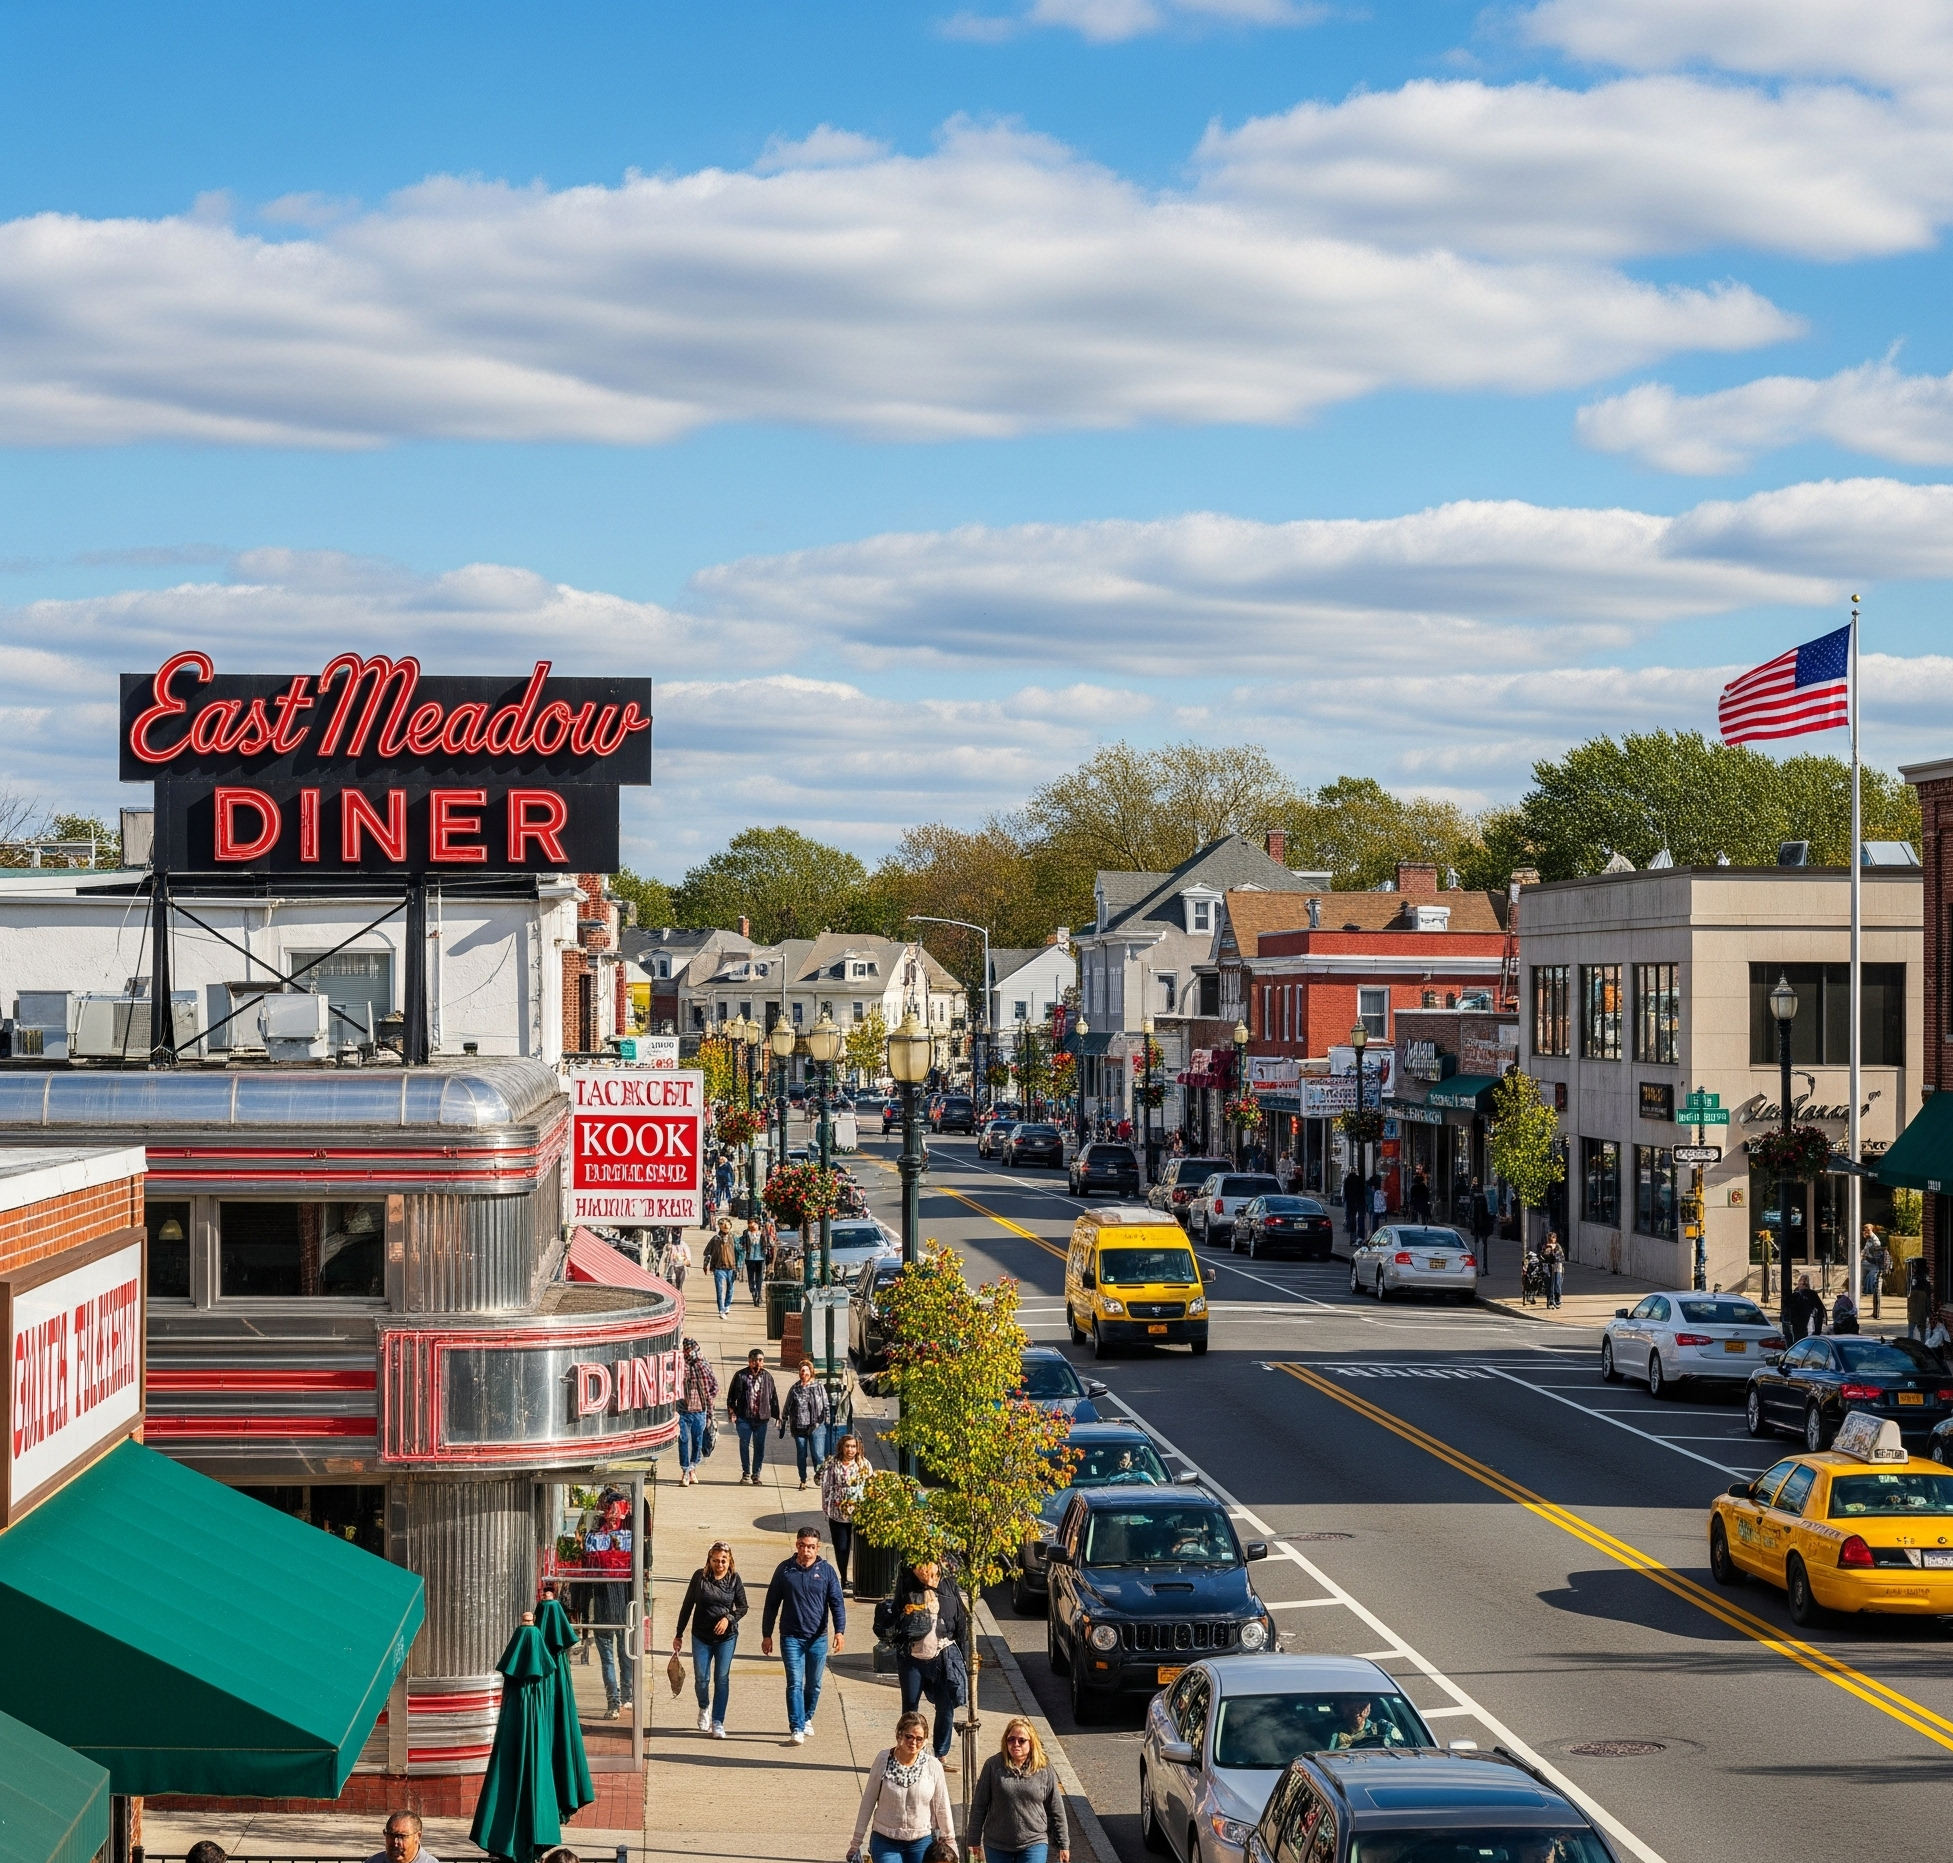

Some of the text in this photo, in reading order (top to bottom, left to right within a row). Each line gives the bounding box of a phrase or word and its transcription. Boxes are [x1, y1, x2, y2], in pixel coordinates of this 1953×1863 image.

[129, 650, 651, 765] East Meadow
[214, 787, 570, 863] DINER
[579, 1122, 693, 1157] KOOK
